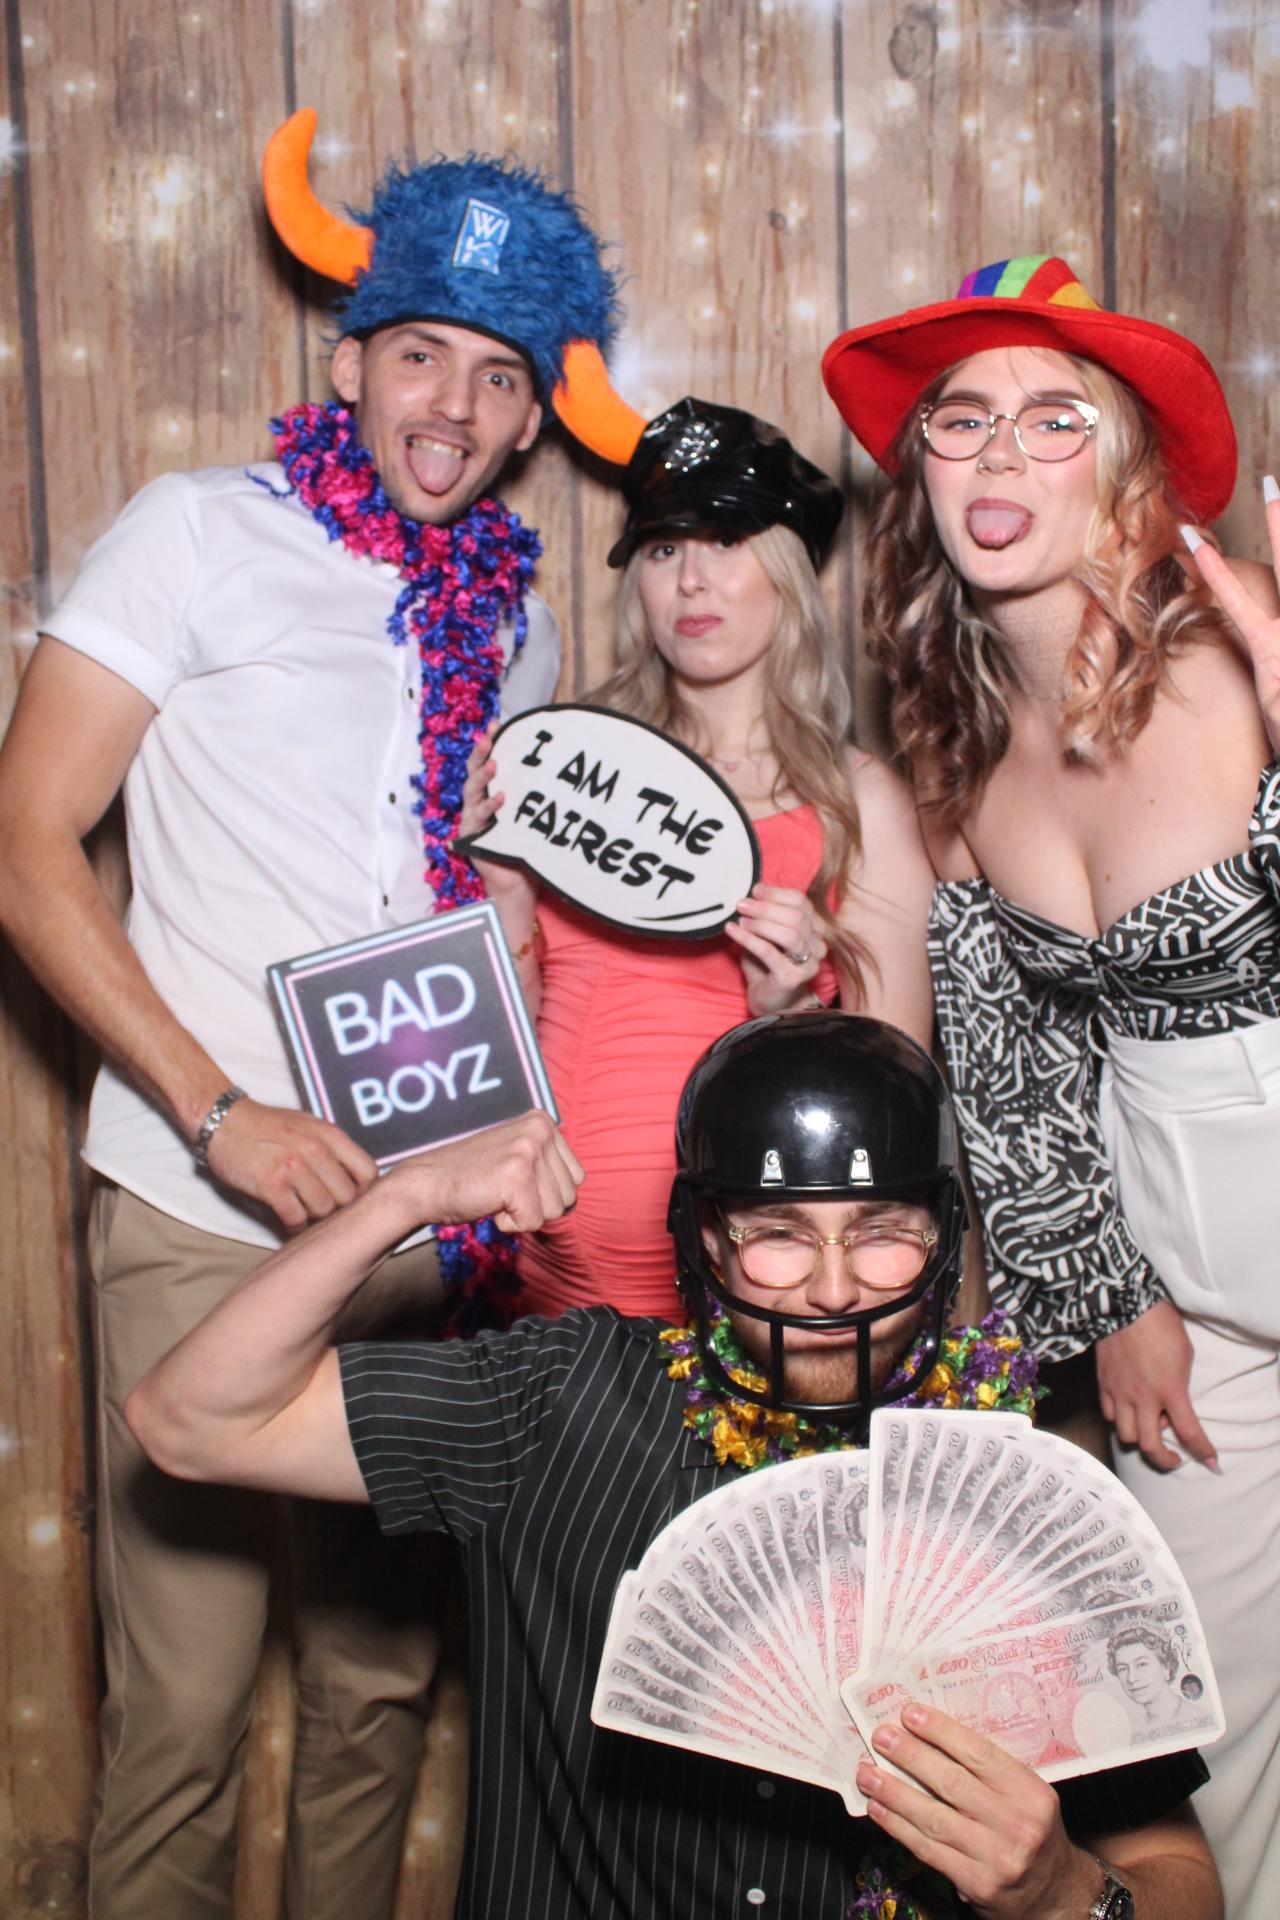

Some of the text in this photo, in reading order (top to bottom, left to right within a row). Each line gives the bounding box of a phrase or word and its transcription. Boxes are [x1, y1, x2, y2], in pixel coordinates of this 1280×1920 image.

[521, 729, 724, 855] I AM THE
[514, 791, 695, 899] FAIREST
[323, 963, 476, 1056] BAD
[350, 1043, 502, 1126] BOYZ
[935, 1657, 968, 1675] £50
[968, 1641, 1019, 1671] Bank
[1032, 1624, 1096, 1650] England
[1041, 1669, 1104, 1697] Pounds
[866, 1684, 895, 1708] £50
